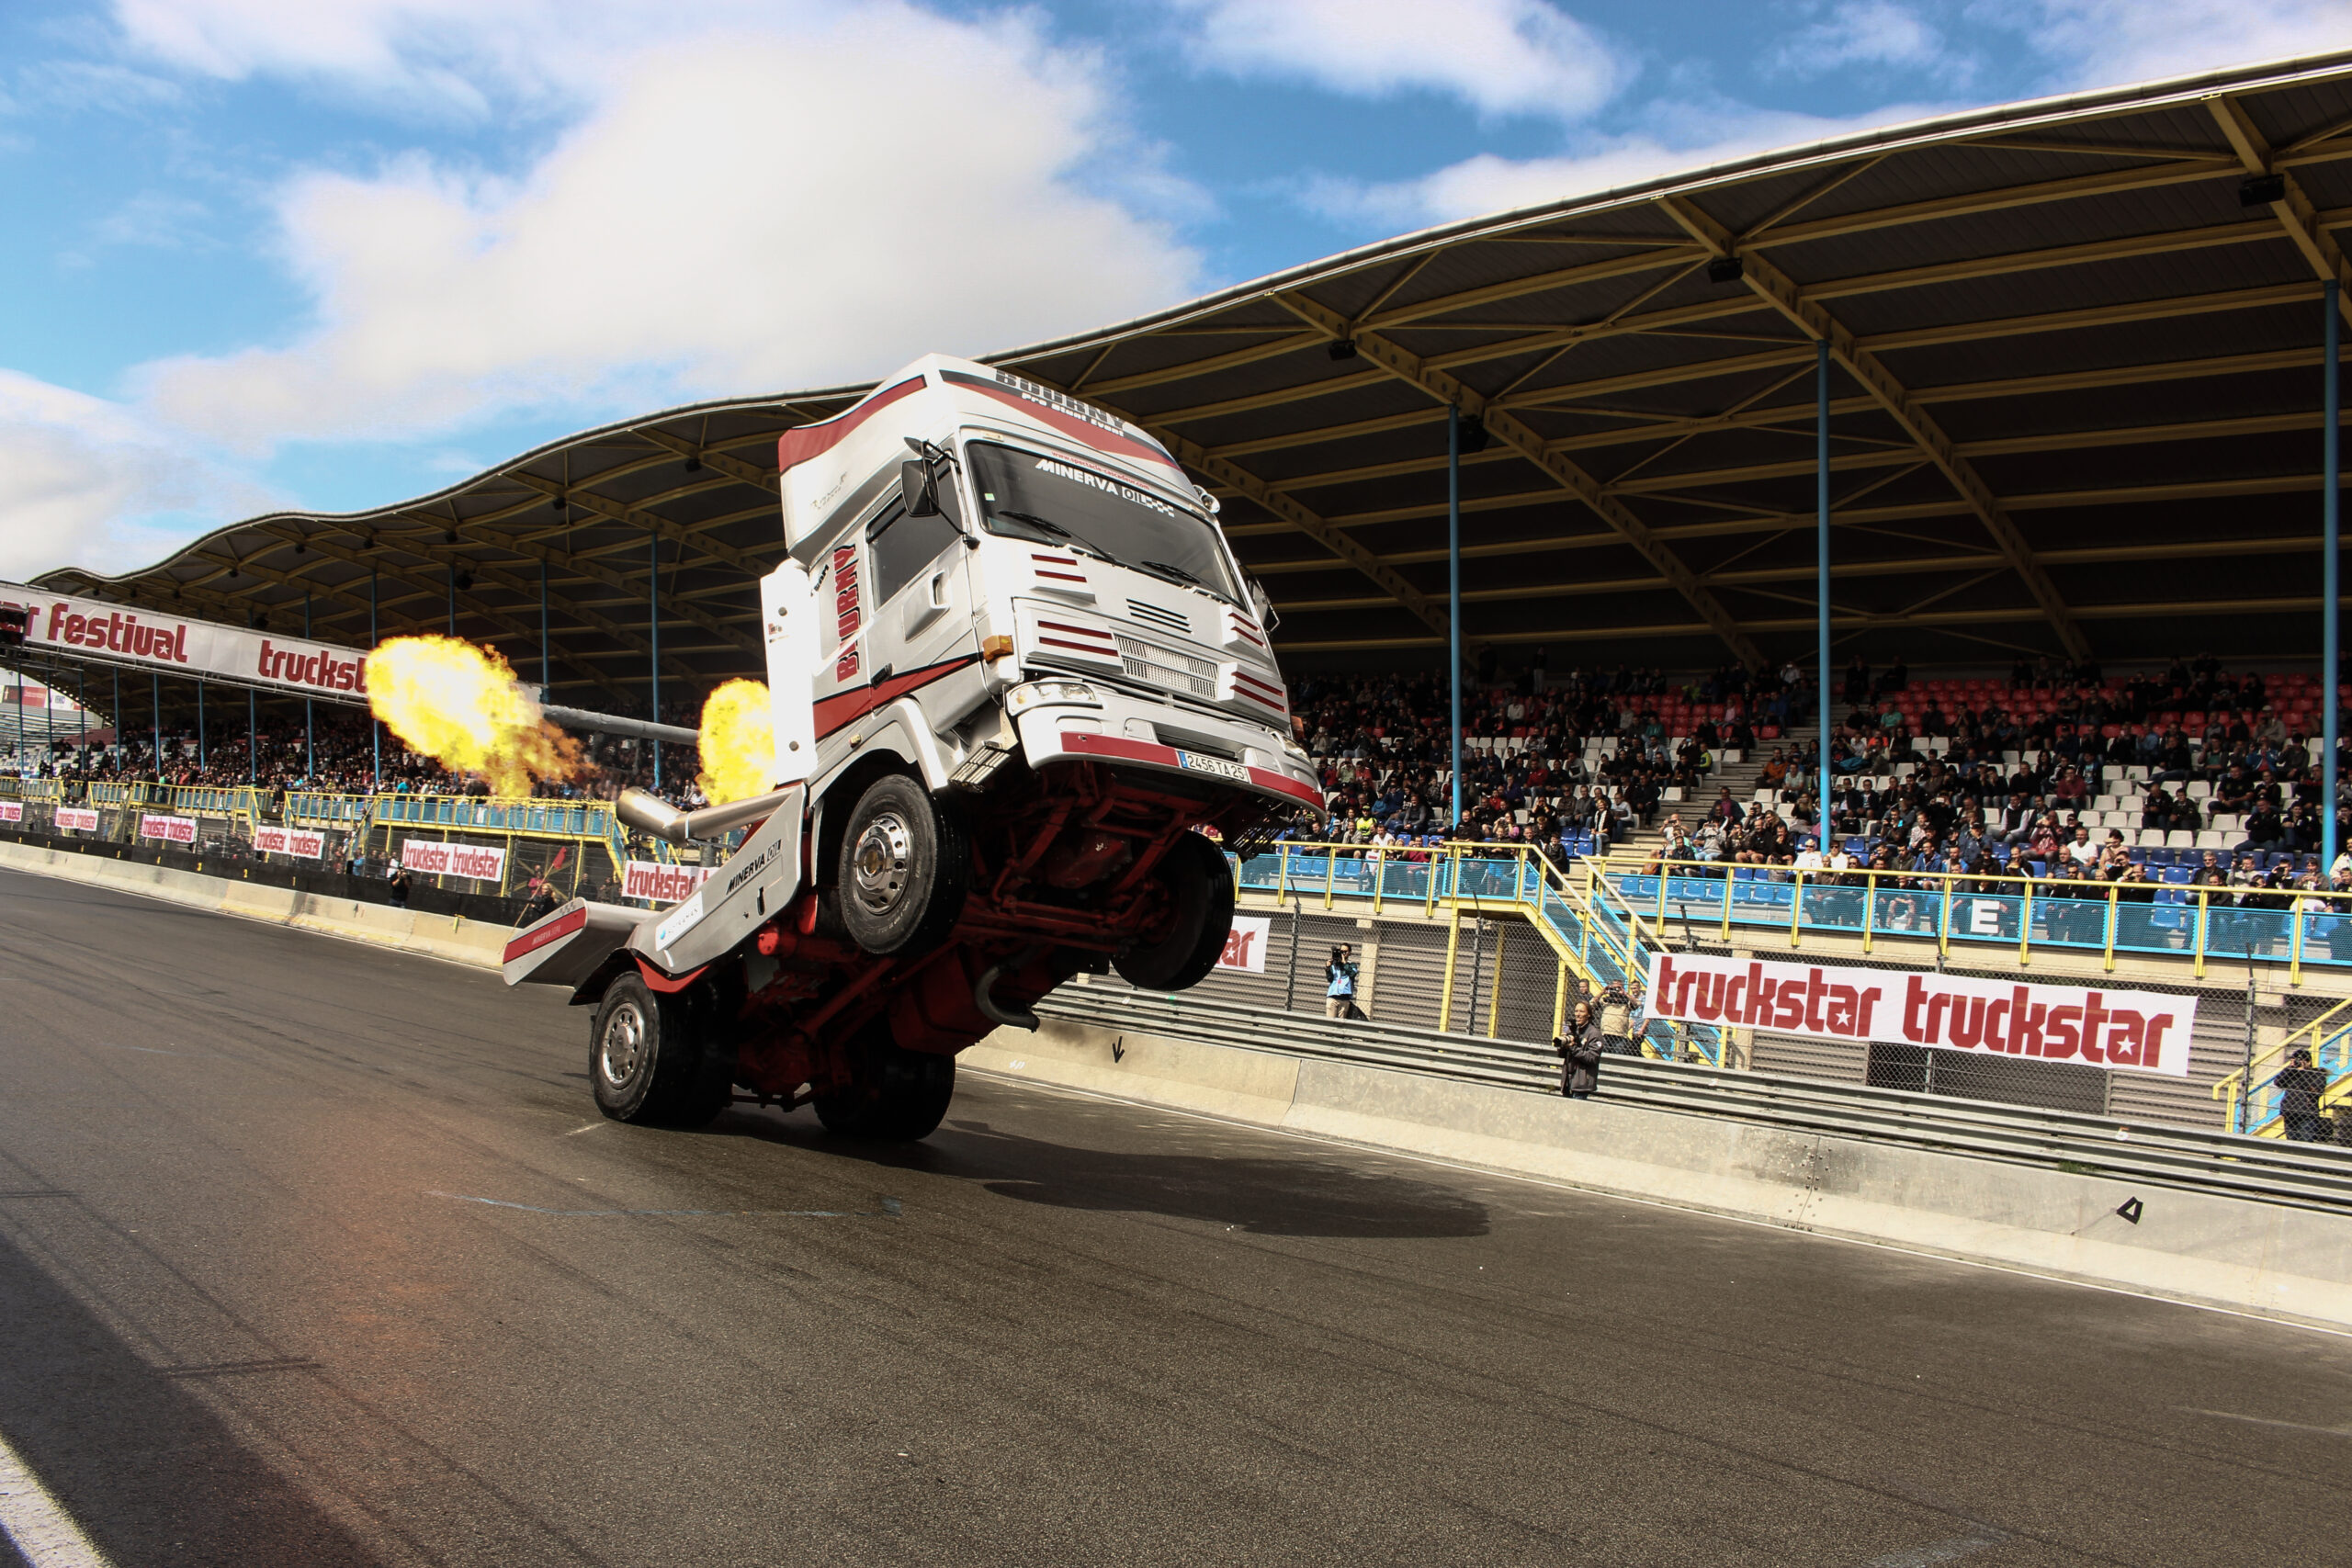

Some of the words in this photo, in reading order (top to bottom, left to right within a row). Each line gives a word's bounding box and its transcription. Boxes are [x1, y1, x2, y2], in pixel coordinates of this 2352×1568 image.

[1022, 392, 1046, 406] Pro
[1035, 458, 1118, 495] MINERVA
[1123, 487, 1147, 505] OIL
[48, 603, 187, 663] festival
[1187, 755, 1215, 773] 2456
[1216, 761, 1231, 777] TA
[1231, 765, 1245, 780] 25
[404, 842, 449, 872] truckstar
[452, 846, 501, 878] truckstar
[726, 853, 765, 896] MINERVA
[627, 863, 695, 900] truckstar
[1970, 899, 2000, 934] E
[1655, 955, 1882, 1037] truckstar
[1903, 975, 2175, 1068] truckstar
